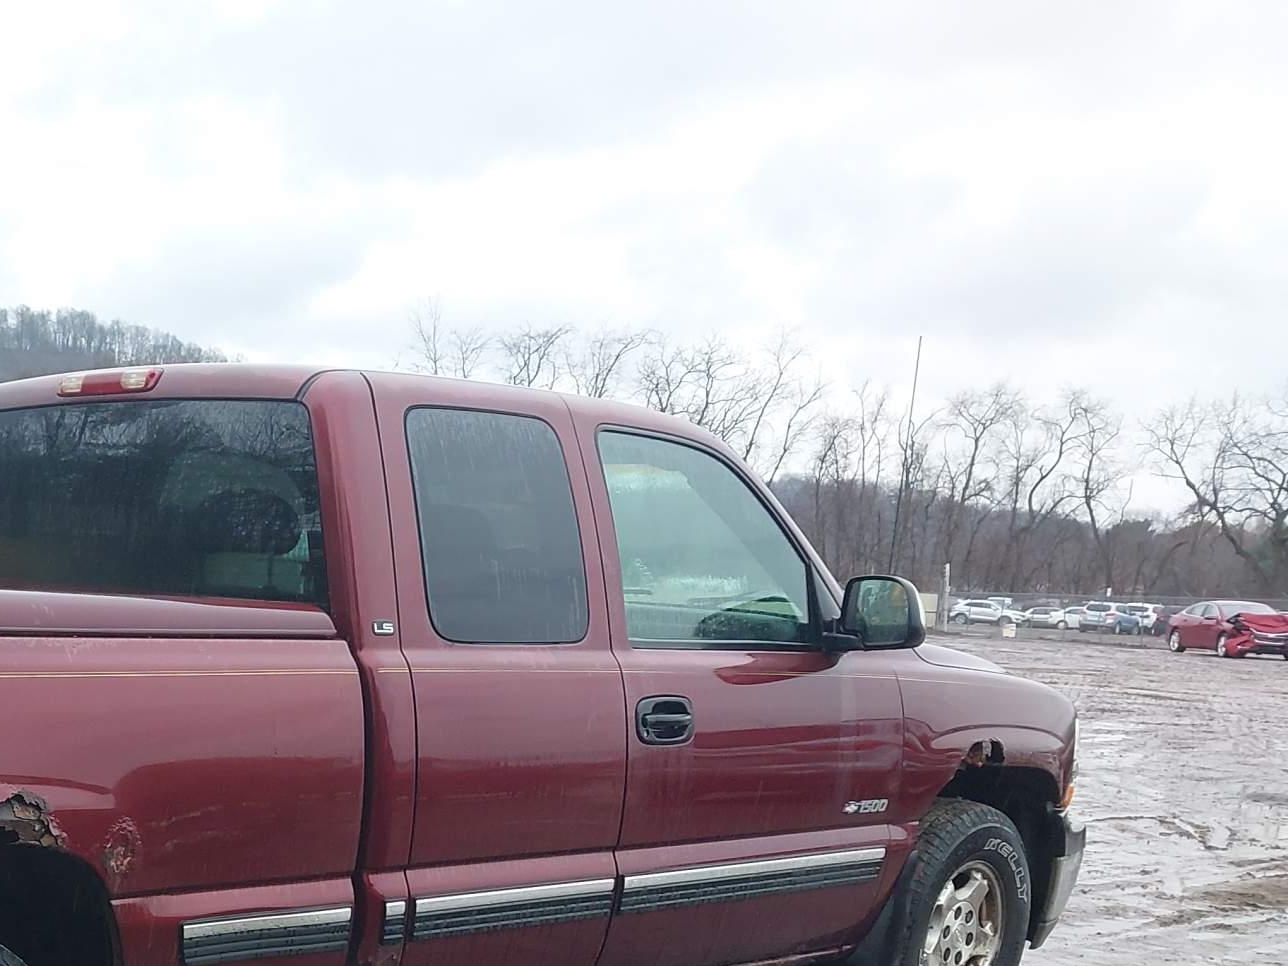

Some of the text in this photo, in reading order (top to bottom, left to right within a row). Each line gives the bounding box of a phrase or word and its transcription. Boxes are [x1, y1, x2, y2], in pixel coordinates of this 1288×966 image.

[373, 622, 394, 633] LS
[856, 799, 889, 813] 1500
[983, 837, 1028, 903] KELLY
